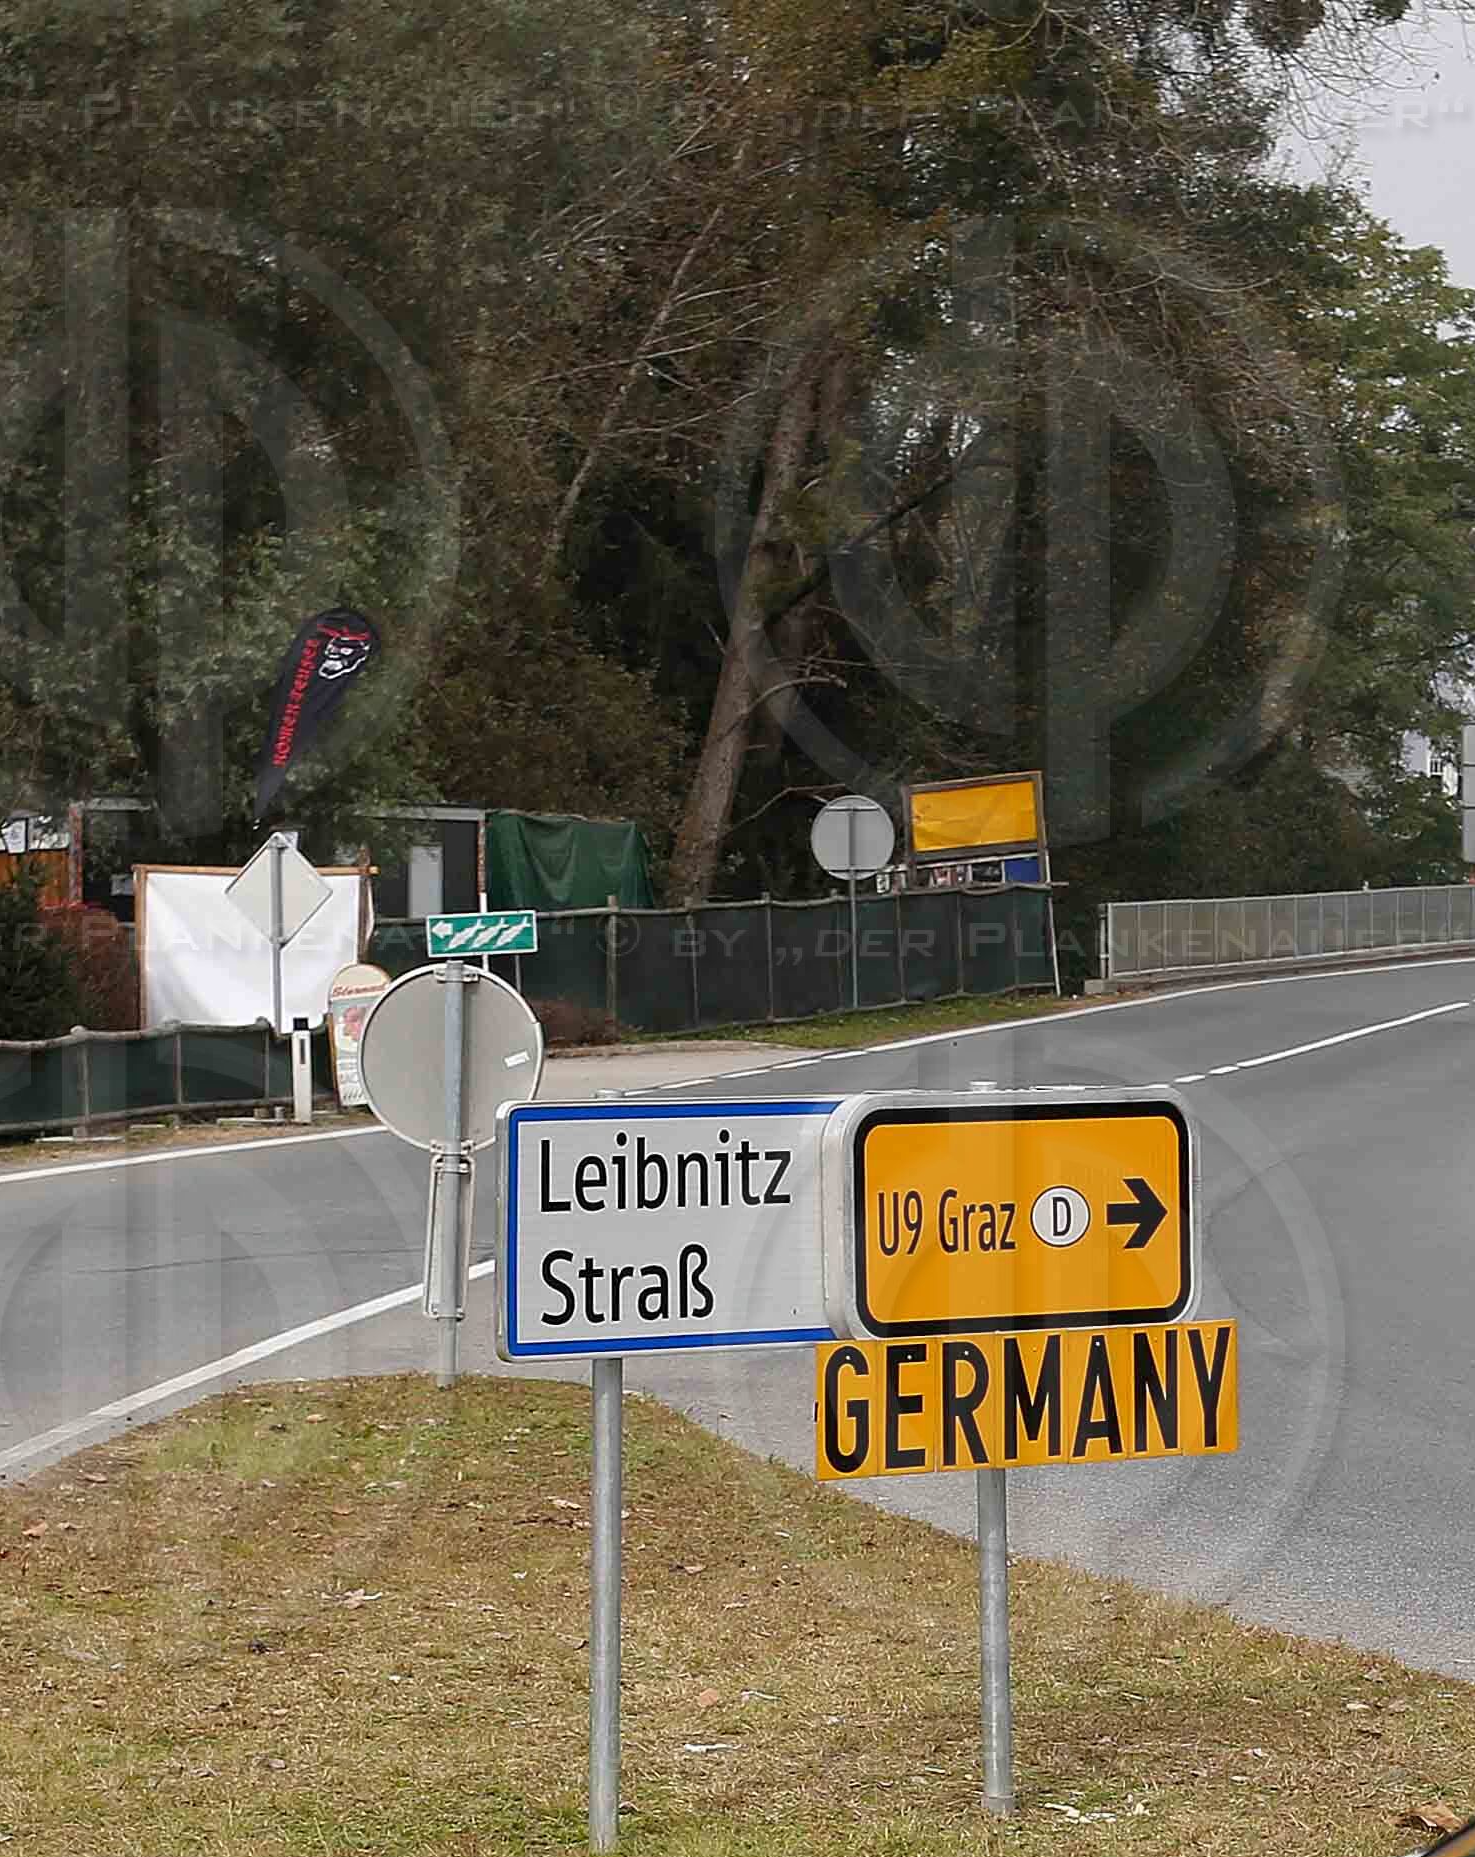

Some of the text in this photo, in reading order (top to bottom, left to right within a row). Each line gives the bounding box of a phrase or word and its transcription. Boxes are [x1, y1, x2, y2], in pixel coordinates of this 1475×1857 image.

[540, 1128, 792, 1213] Leibnitz
[878, 1189, 1072, 1256] U9 Graz D
[540, 1243, 714, 1326] Straß
[824, 1326, 1232, 1474] GERMANY
